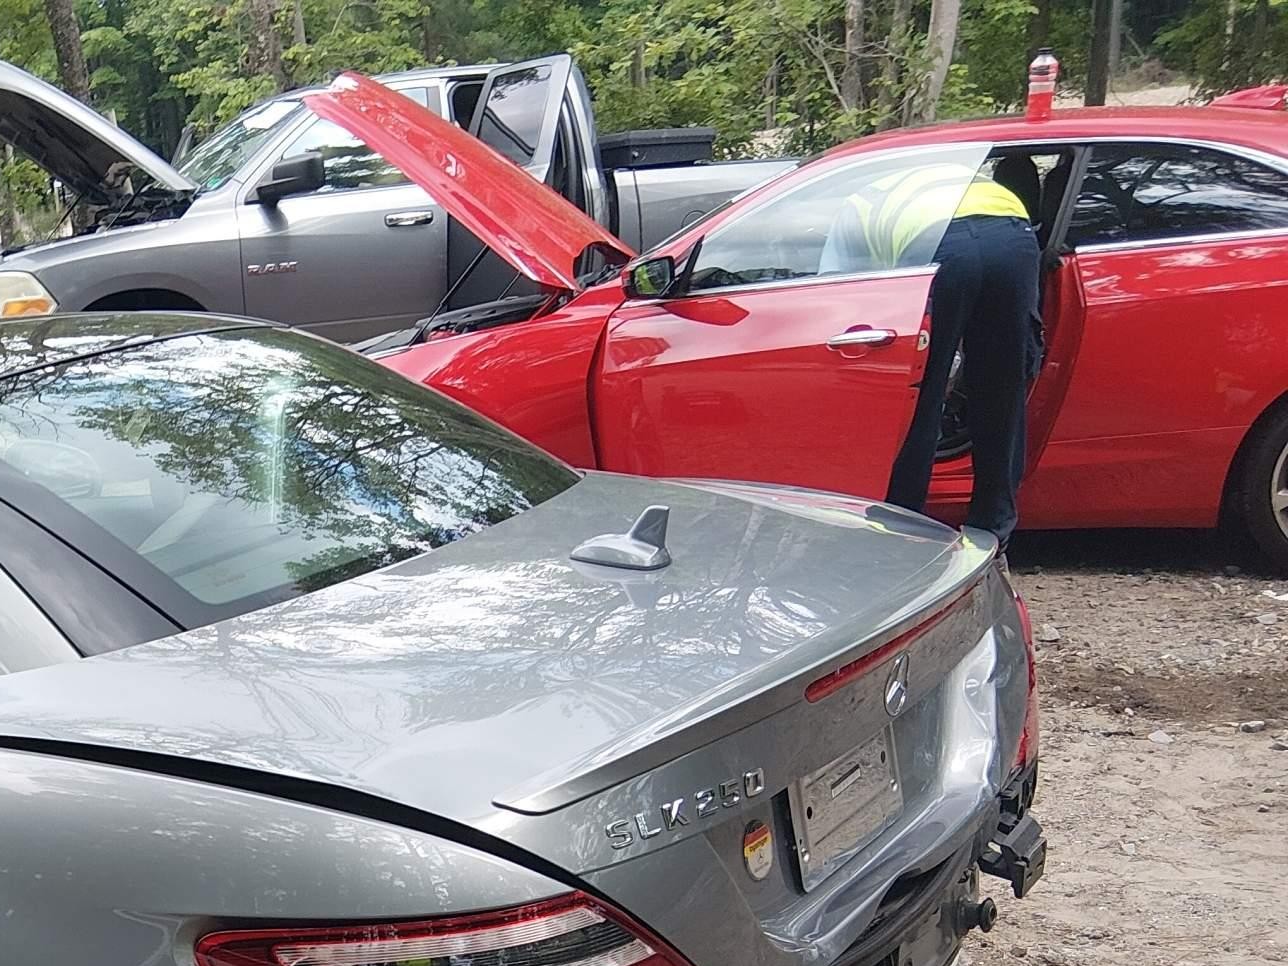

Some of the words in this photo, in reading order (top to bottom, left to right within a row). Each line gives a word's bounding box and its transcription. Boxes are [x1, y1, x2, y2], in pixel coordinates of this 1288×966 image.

[247, 261, 298, 276] RAM
[605, 798, 690, 850] SLK
[694, 767, 766, 818] 250
